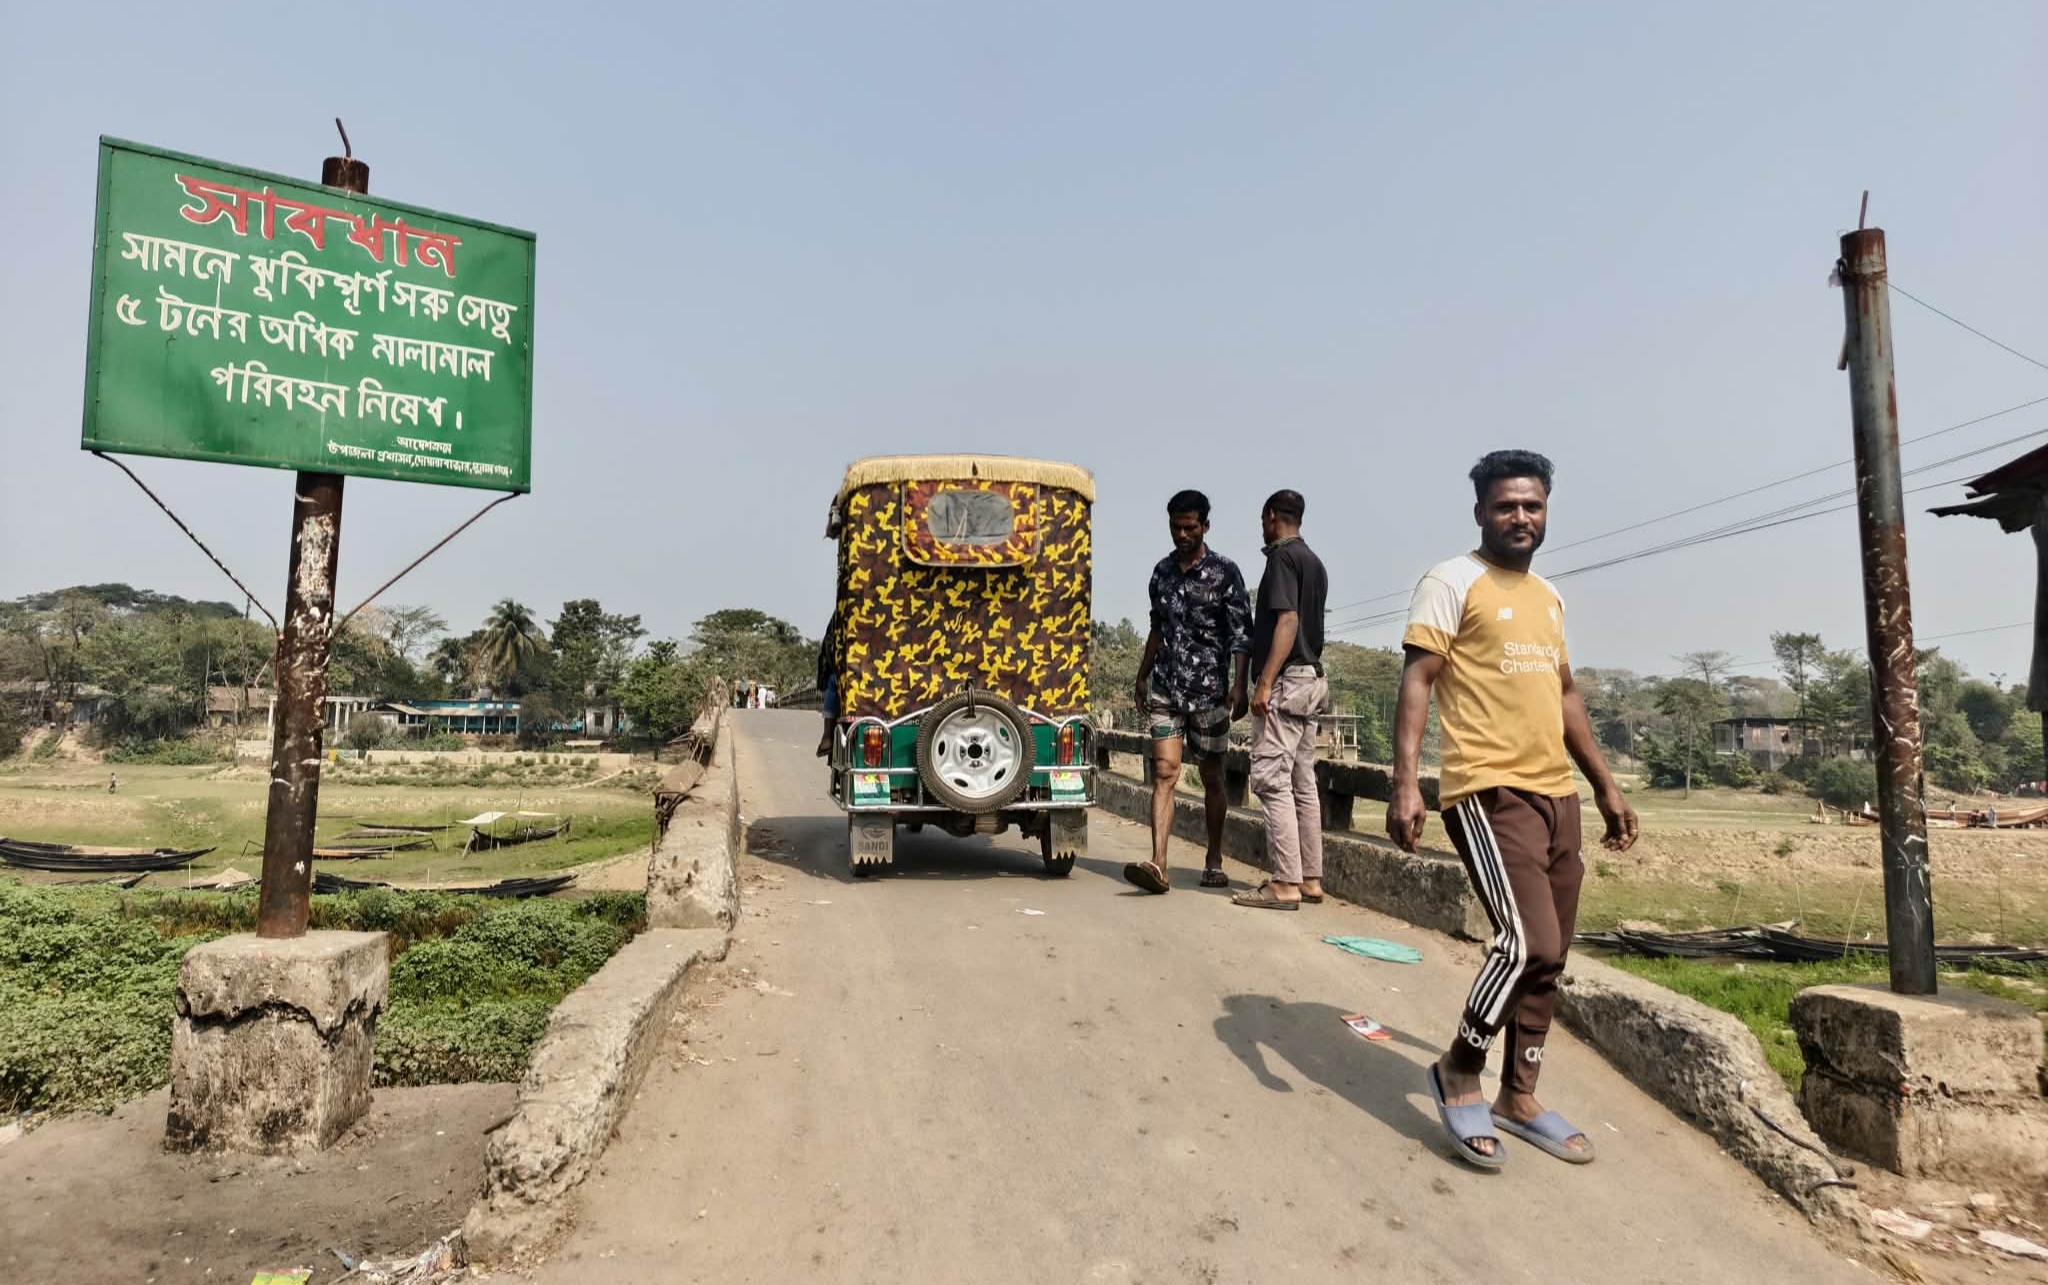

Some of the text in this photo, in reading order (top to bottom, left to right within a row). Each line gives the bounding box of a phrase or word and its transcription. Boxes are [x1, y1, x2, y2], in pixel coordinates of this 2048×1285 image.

[175, 173, 463, 278] সাবধান
[116, 285, 496, 382] ৫ টনের অধিক মালামাল
[121, 232, 241, 284] সামনে
[391, 281, 455, 322] সরু
[457, 295, 519, 345] সেতু
[210, 360, 350, 418] পরিবহন
